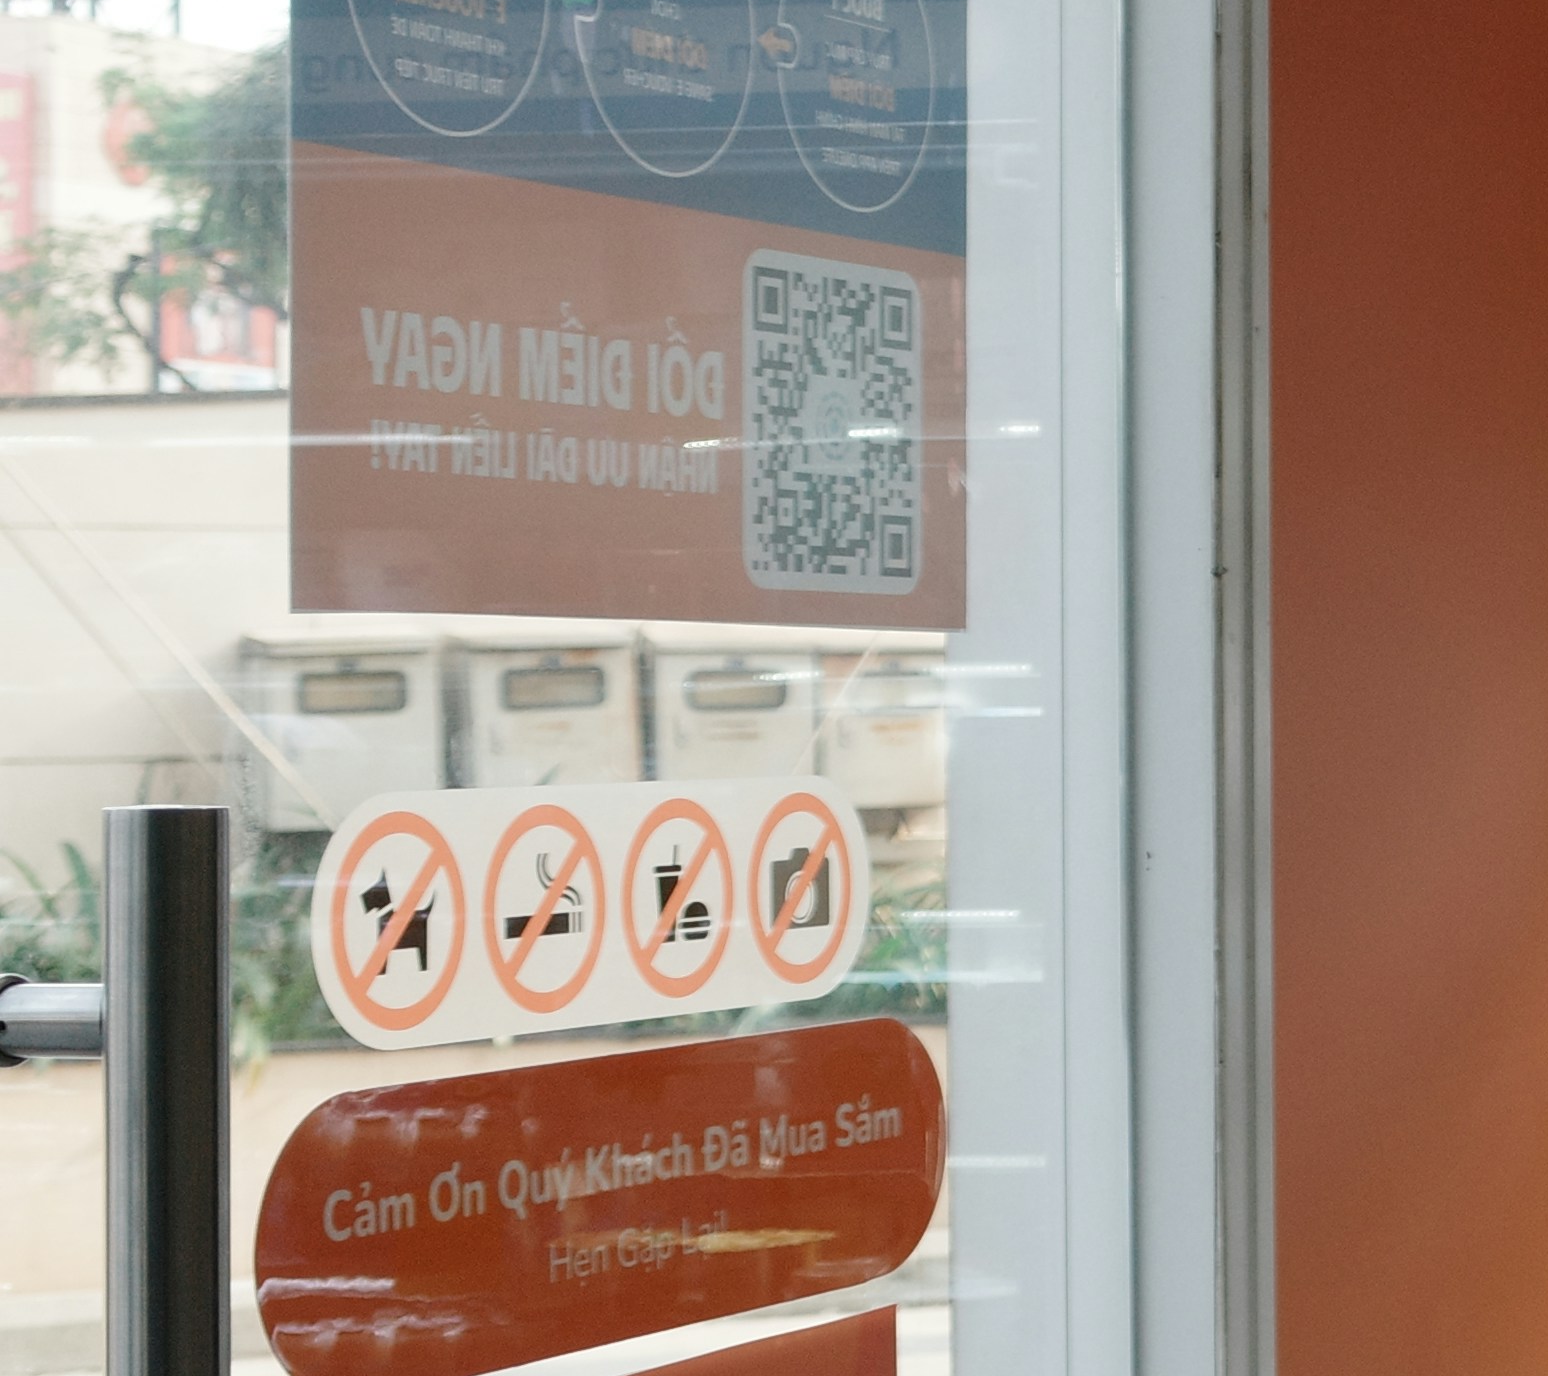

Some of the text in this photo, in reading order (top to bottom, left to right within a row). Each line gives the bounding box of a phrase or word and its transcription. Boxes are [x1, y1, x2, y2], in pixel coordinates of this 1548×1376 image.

[322, 1090, 901, 1242] Cảm Ơn Quý Khách Đã Mua Sắm
[549, 1236, 610, 1285] Hẹn
